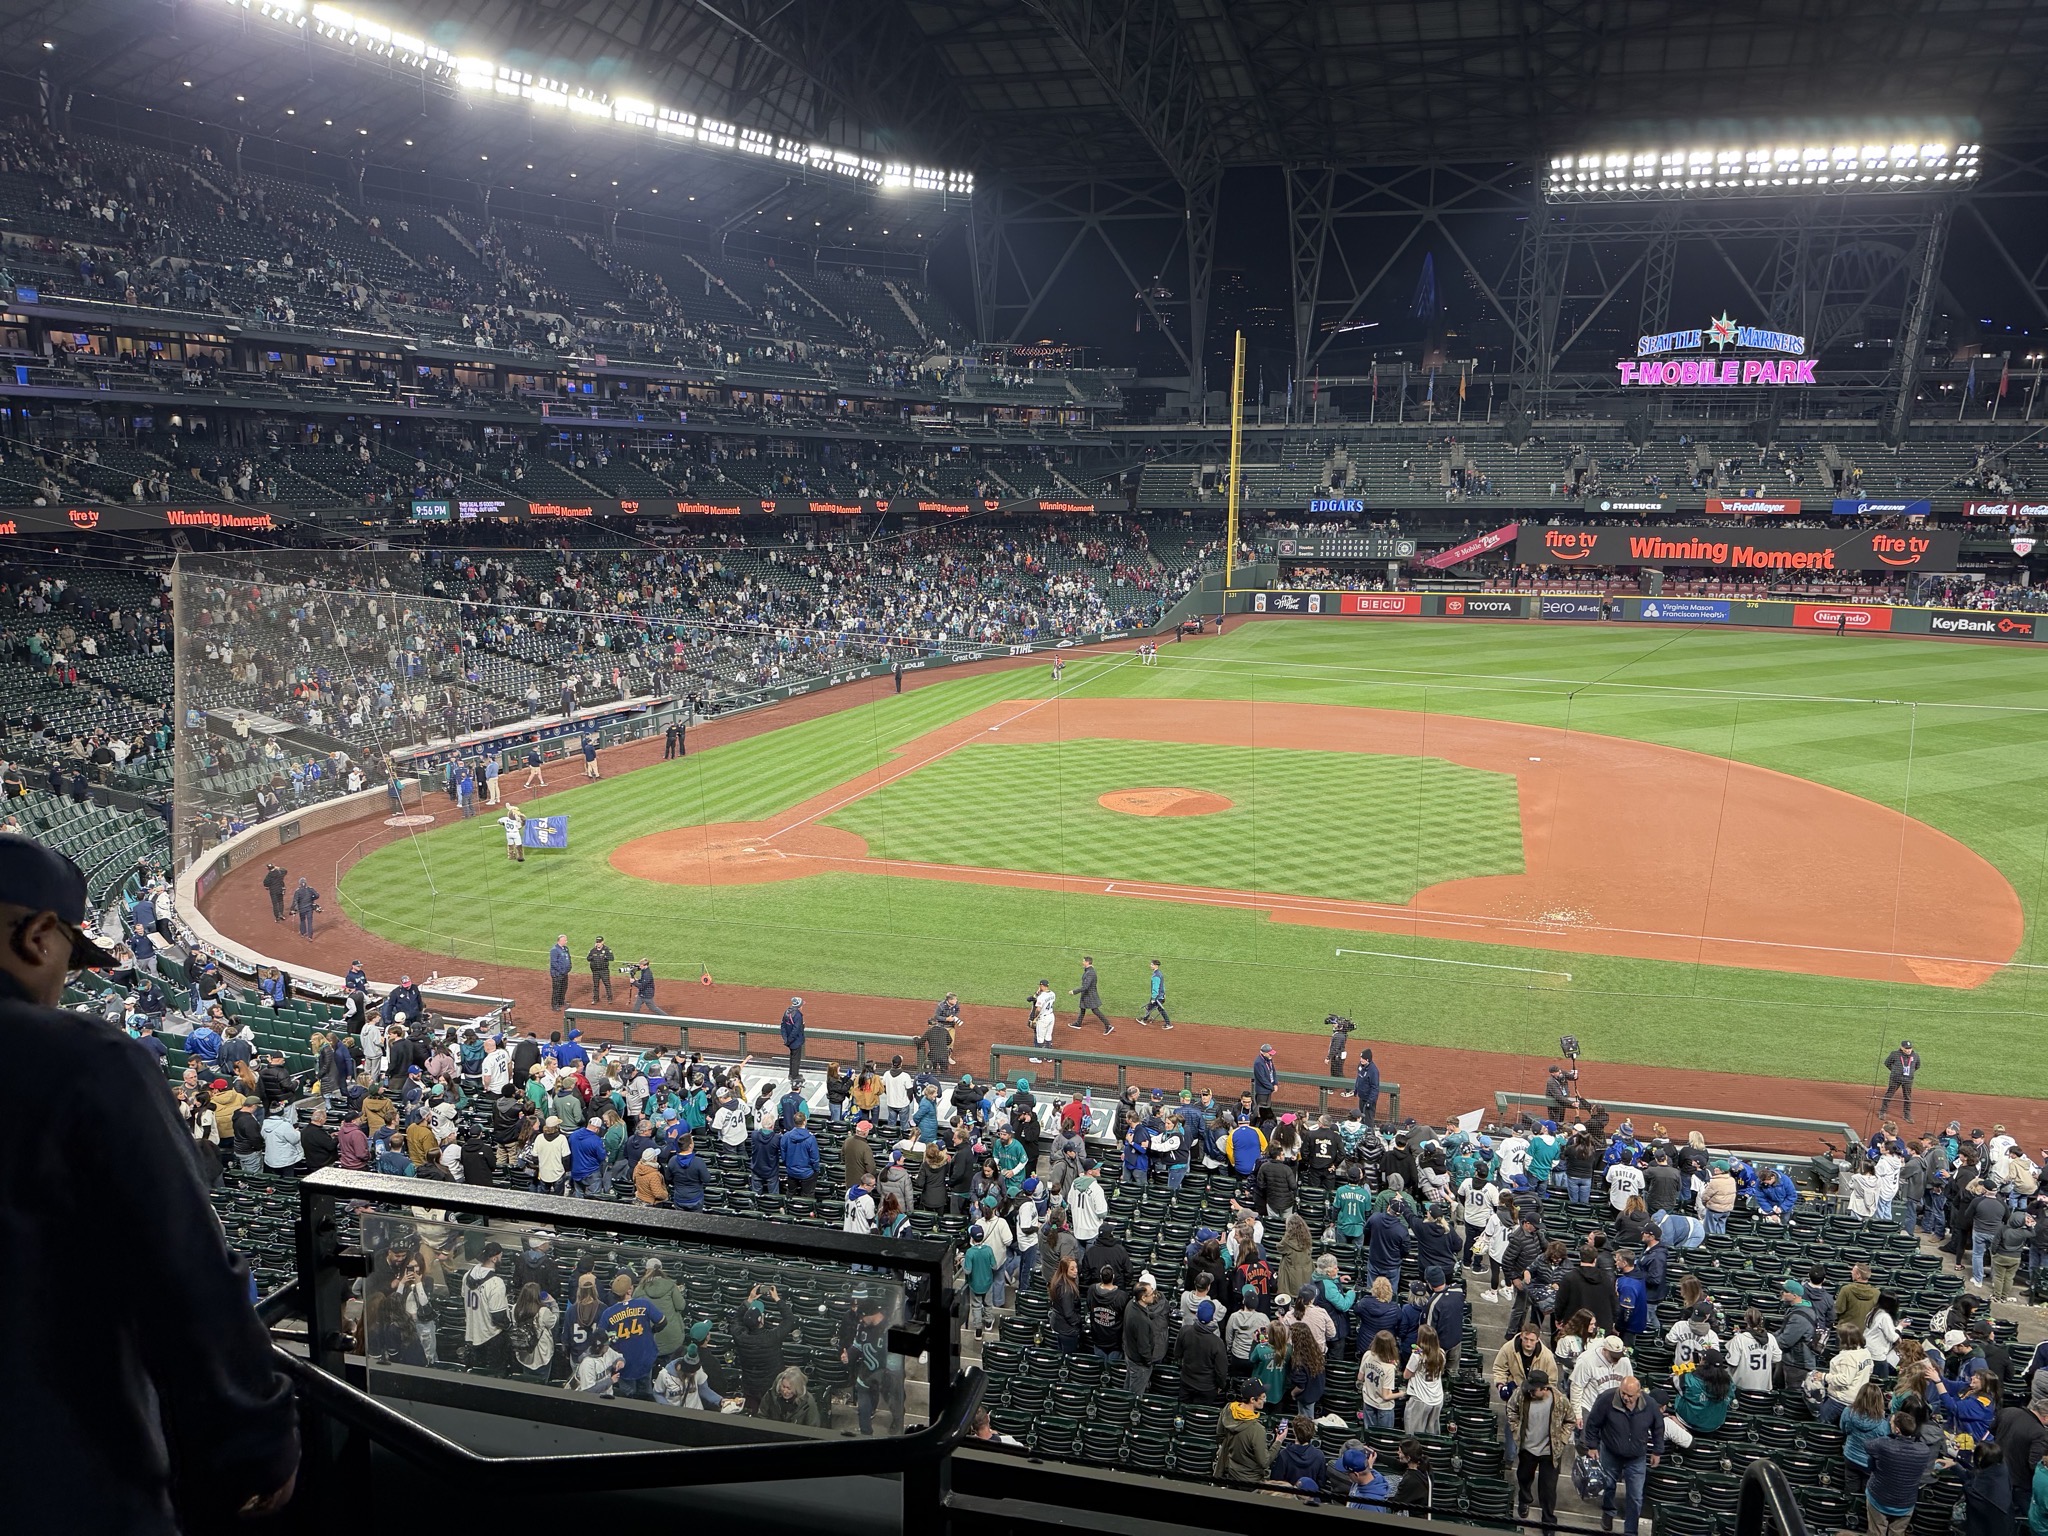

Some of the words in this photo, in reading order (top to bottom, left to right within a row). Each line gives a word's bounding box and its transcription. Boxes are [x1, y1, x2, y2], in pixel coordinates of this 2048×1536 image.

[1638, 329, 1702, 356] SEATTLE
[1738, 326, 1805, 355] MARINERS
[1617, 361, 1739, 385] T-MOBILE
[1743, 360, 1819, 384] PARK
[416, 505, 433, 515] 9:56
[434, 505, 446, 515] PM
[529, 503, 560, 516] Winning
[560, 506, 592, 517] Moment
[677, 502, 709, 514] Winning
[710, 506, 741, 515] Moment
[809, 502, 836, 514] Winning
[836, 504, 862, 514] Moment
[918, 502, 942, 513] Winning
[941, 503, 970, 513] Moment
[1039, 501, 1067, 512] Winning
[1067, 503, 1094, 512] Moment
[1612, 502, 1662, 510] STARBUCKS
[69, 510, 88, 521] fire
[88, 511, 99, 521] tv
[167, 510, 220, 526] Winning
[221, 514, 272, 527] Moment
[1545, 530, 1576, 547] fire
[1579, 532, 1597, 547] tv
[1872, 534, 1906, 552] fire
[1910, 536, 1930, 552] tv
[1630, 537, 1728, 564] Winning
[1731, 546, 1835, 569] Moment
[2016, 544, 2028, 552] 42
[1468, 602, 1511, 611] TOYOTA
[1543, 602, 1575, 613] eero
[1662, 603, 1691, 612] Virginia
[1932, 617, 1995, 632] KeyBank
[951, 653, 968, 663] Great
[1009, 646, 1033, 656] STIHL
[498, 1061, 507, 1073] 12
[731, 1112, 744, 1128] 34
[1320, 1144, 1327, 1155] S
[1512, 1153, 1526, 1166] 44
[1617, 1178, 1631, 1192] 12
[1077, 1193, 1085, 1209] 11
[1340, 1192, 1366, 1203] MARTINEZ
[1470, 1191, 1484, 1206] 19
[844, 1204, 857, 1222] 44
[1348, 1202, 1357, 1216] 11
[467, 1290, 479, 1310] 10
[608, 1307, 647, 1325] RODRÍGUEZ
[617, 1318, 644, 1339] 44
[1749, 1354, 1767, 1371] 51
[1366, 1371, 1380, 1388] 44
